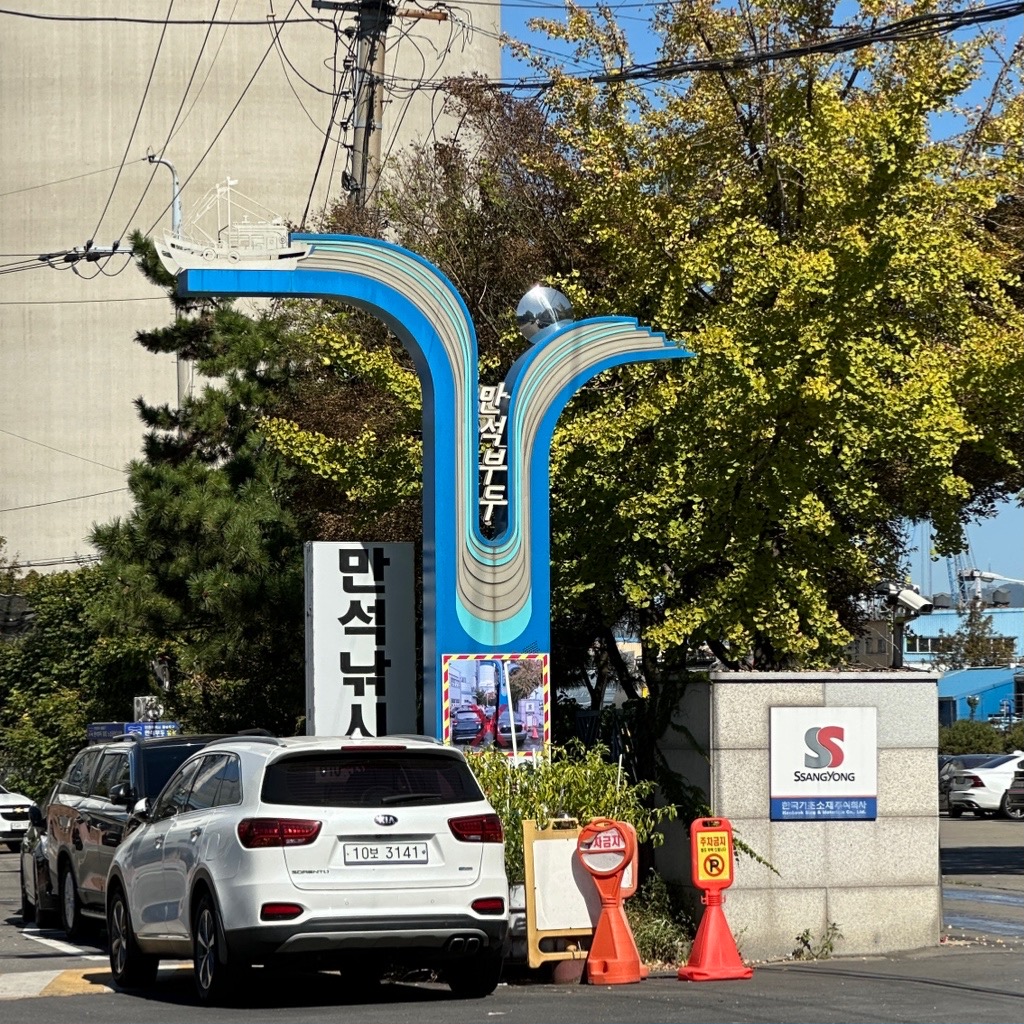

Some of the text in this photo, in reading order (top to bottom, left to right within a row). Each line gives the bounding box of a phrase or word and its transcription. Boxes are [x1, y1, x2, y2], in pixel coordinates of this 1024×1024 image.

[479, 382, 511, 523] 만석부두
[337, 547, 392, 738] 만석낚시
[592, 835, 622, 848] 차금지
[700, 836, 726, 847] 주차금지
[353, 845, 418, 860] 10보 3141
